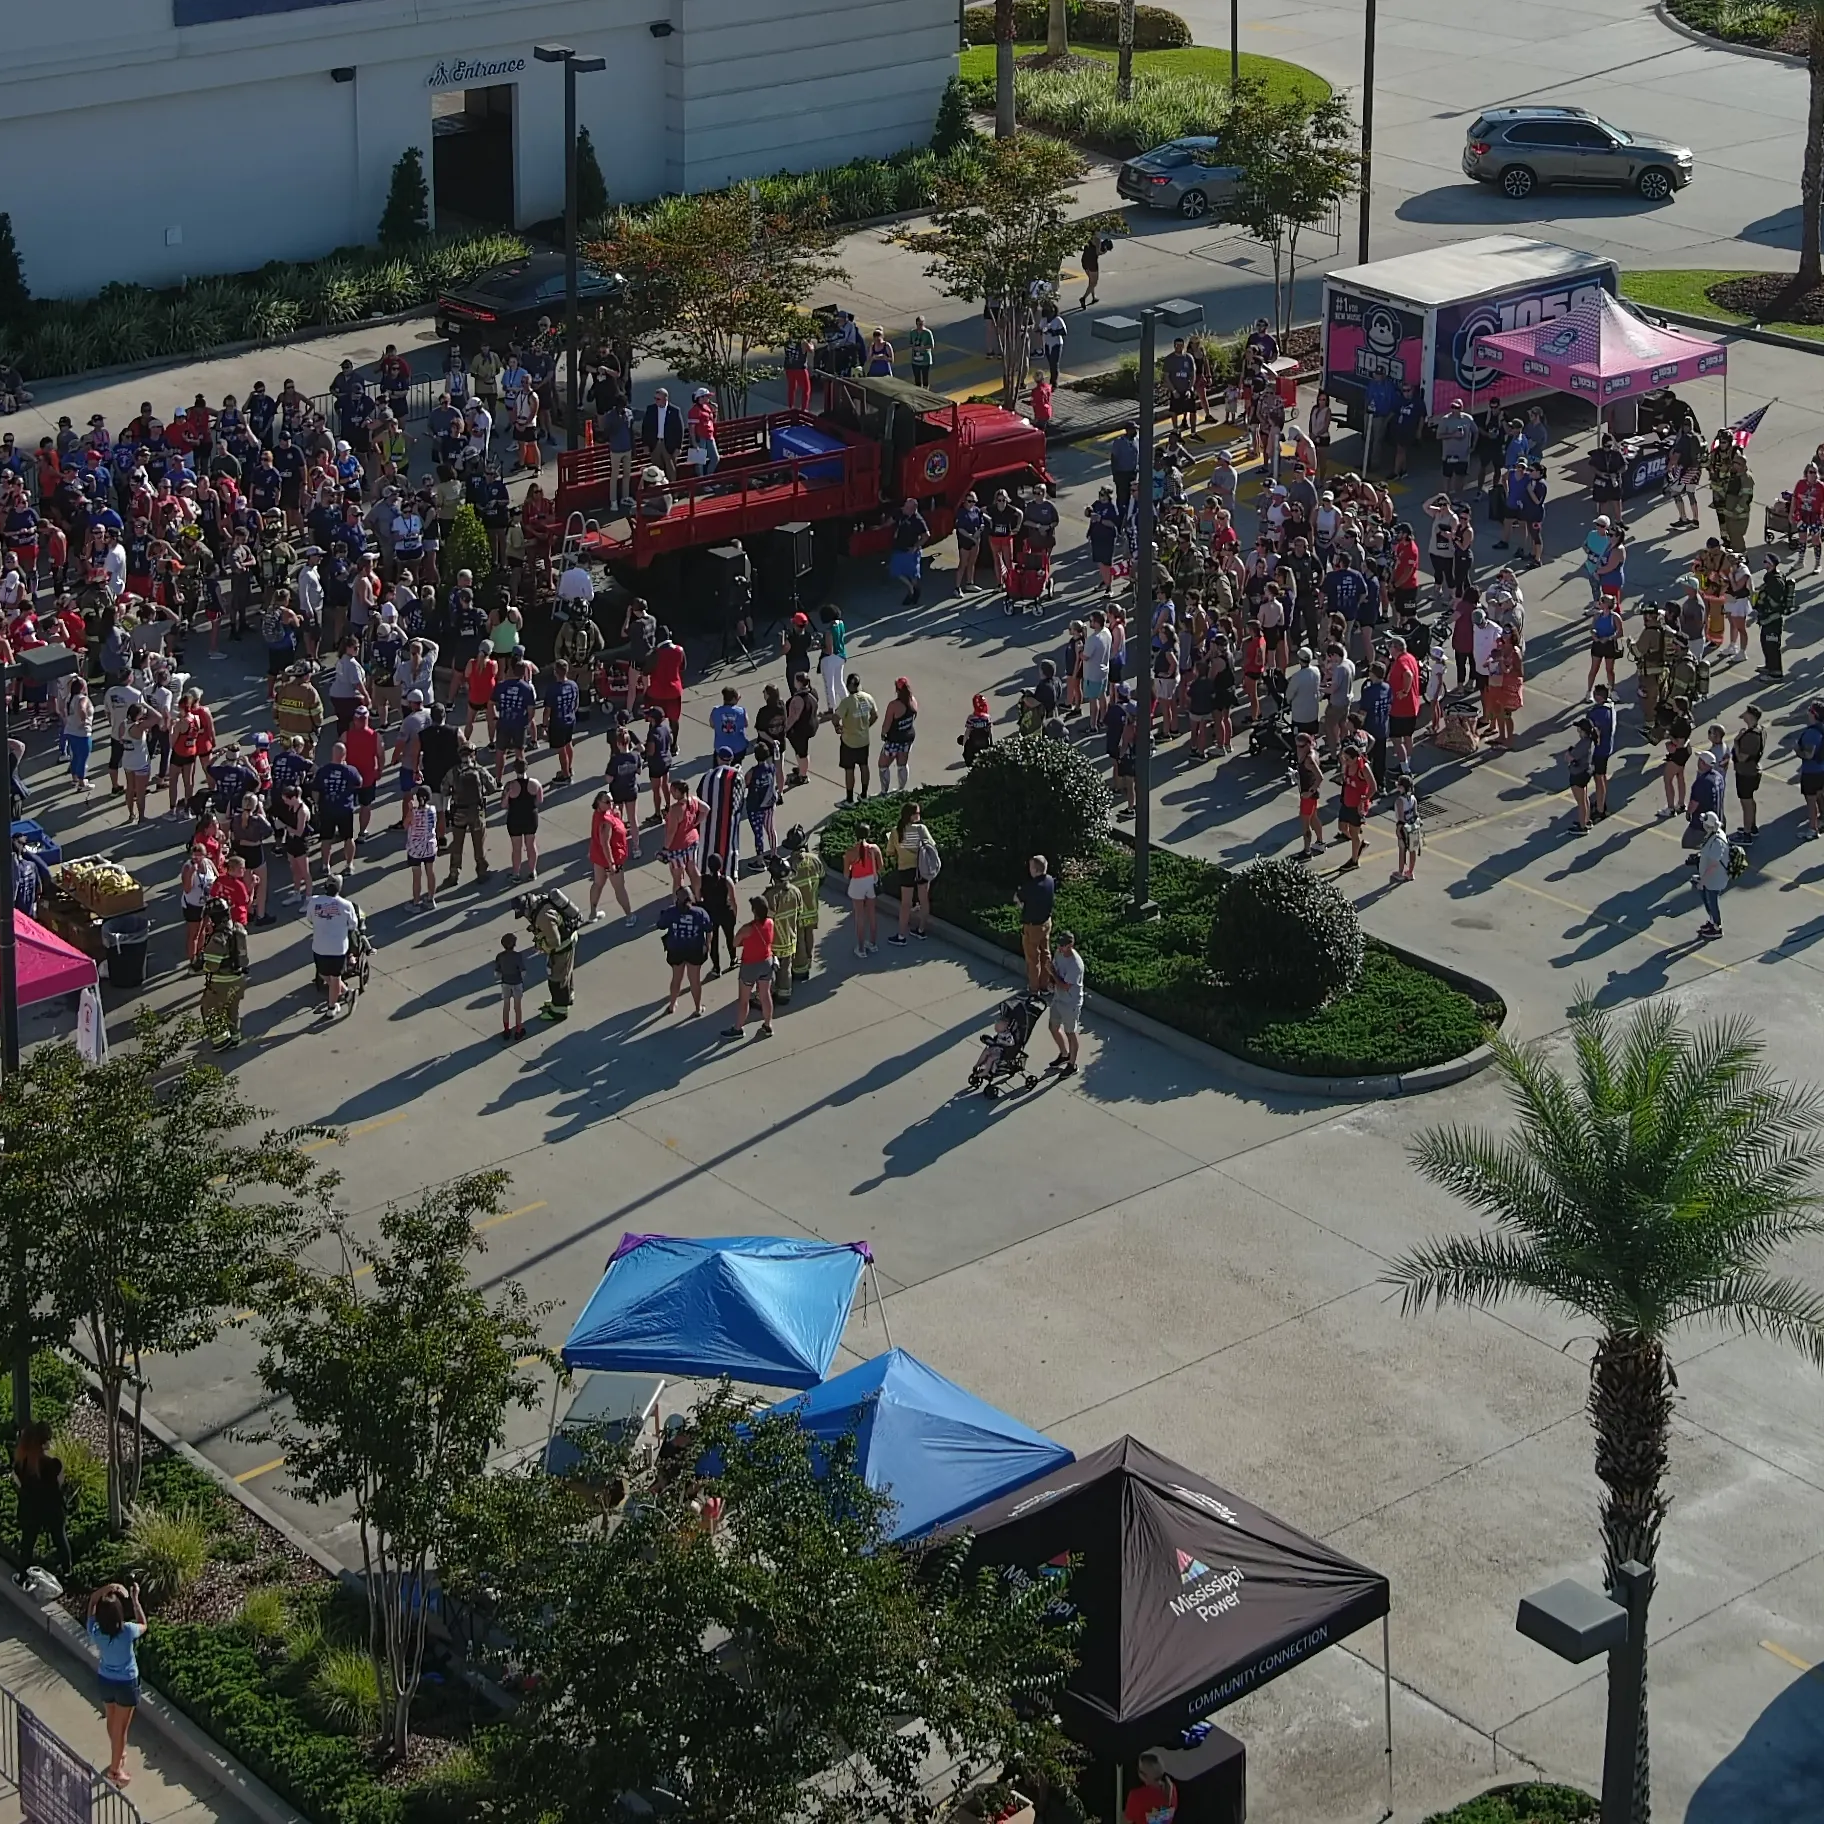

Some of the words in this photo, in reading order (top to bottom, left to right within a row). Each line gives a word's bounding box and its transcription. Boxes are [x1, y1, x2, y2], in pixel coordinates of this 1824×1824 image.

[452, 57, 526, 82] Entrance
[1169, 1564, 1246, 1617] Mississippi
[1195, 1590, 1241, 1623] Power
[1188, 1665, 1257, 1715] COMMUNITY
[1258, 1624, 1329, 1676] CONNECTION
